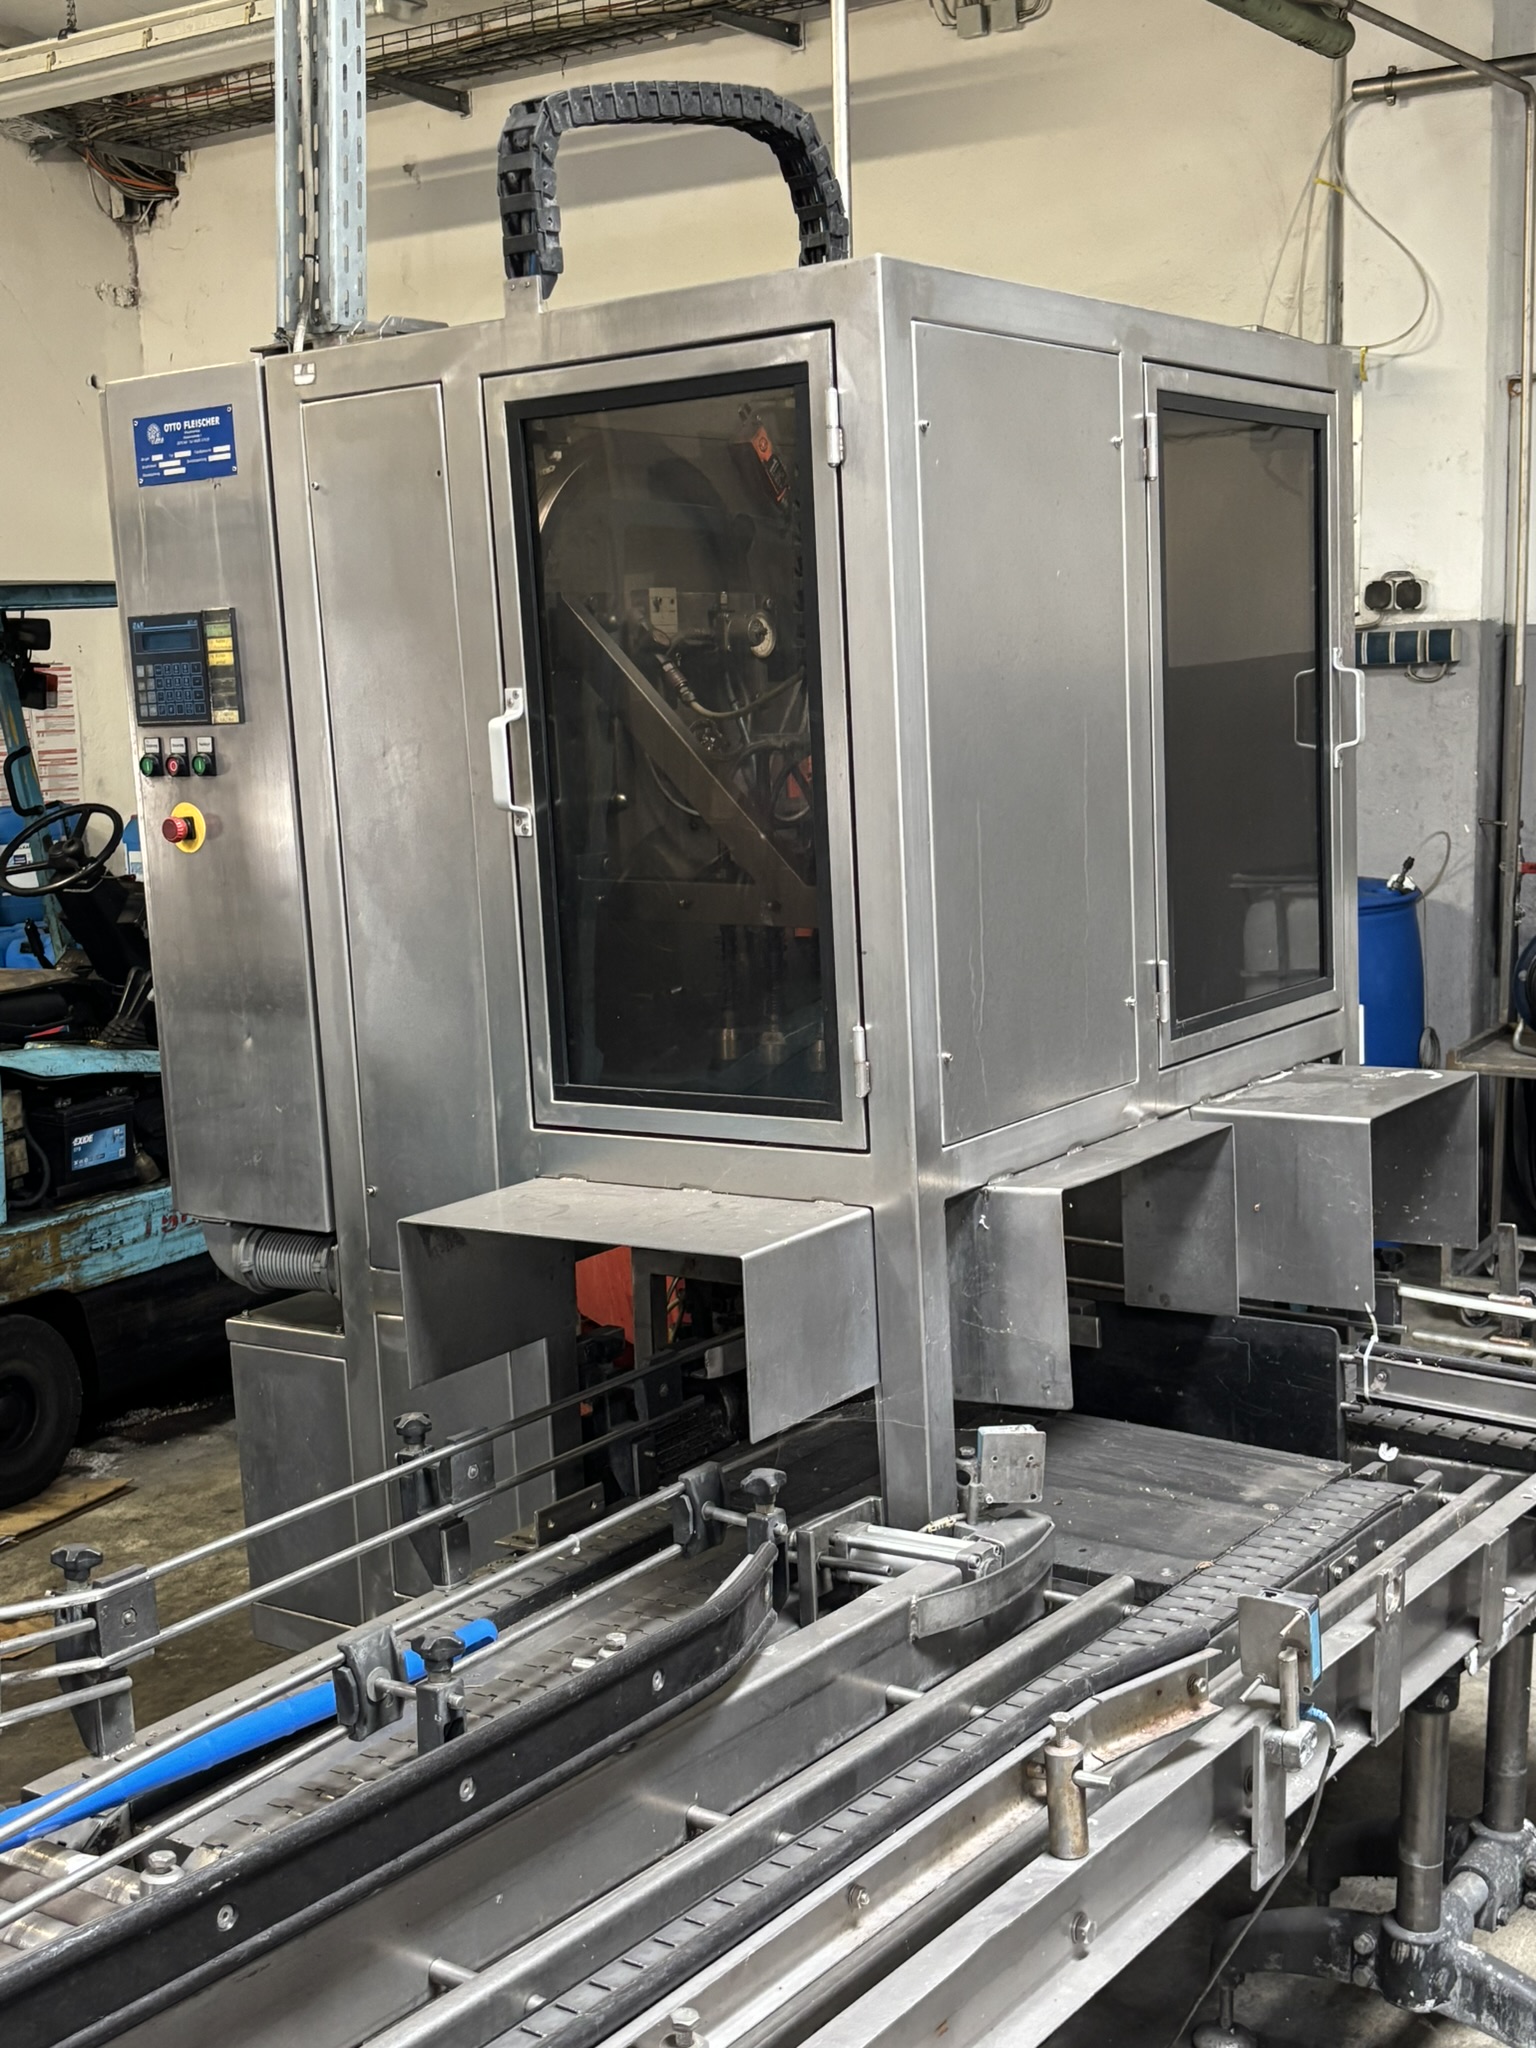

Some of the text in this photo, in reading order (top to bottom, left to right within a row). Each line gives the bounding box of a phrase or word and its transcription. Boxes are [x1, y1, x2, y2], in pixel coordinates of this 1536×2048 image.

[164, 422, 182, 432] OTTO
[183, 416, 220, 429] FLEISCHER
[72, 1134, 93, 1146] EXIDE
